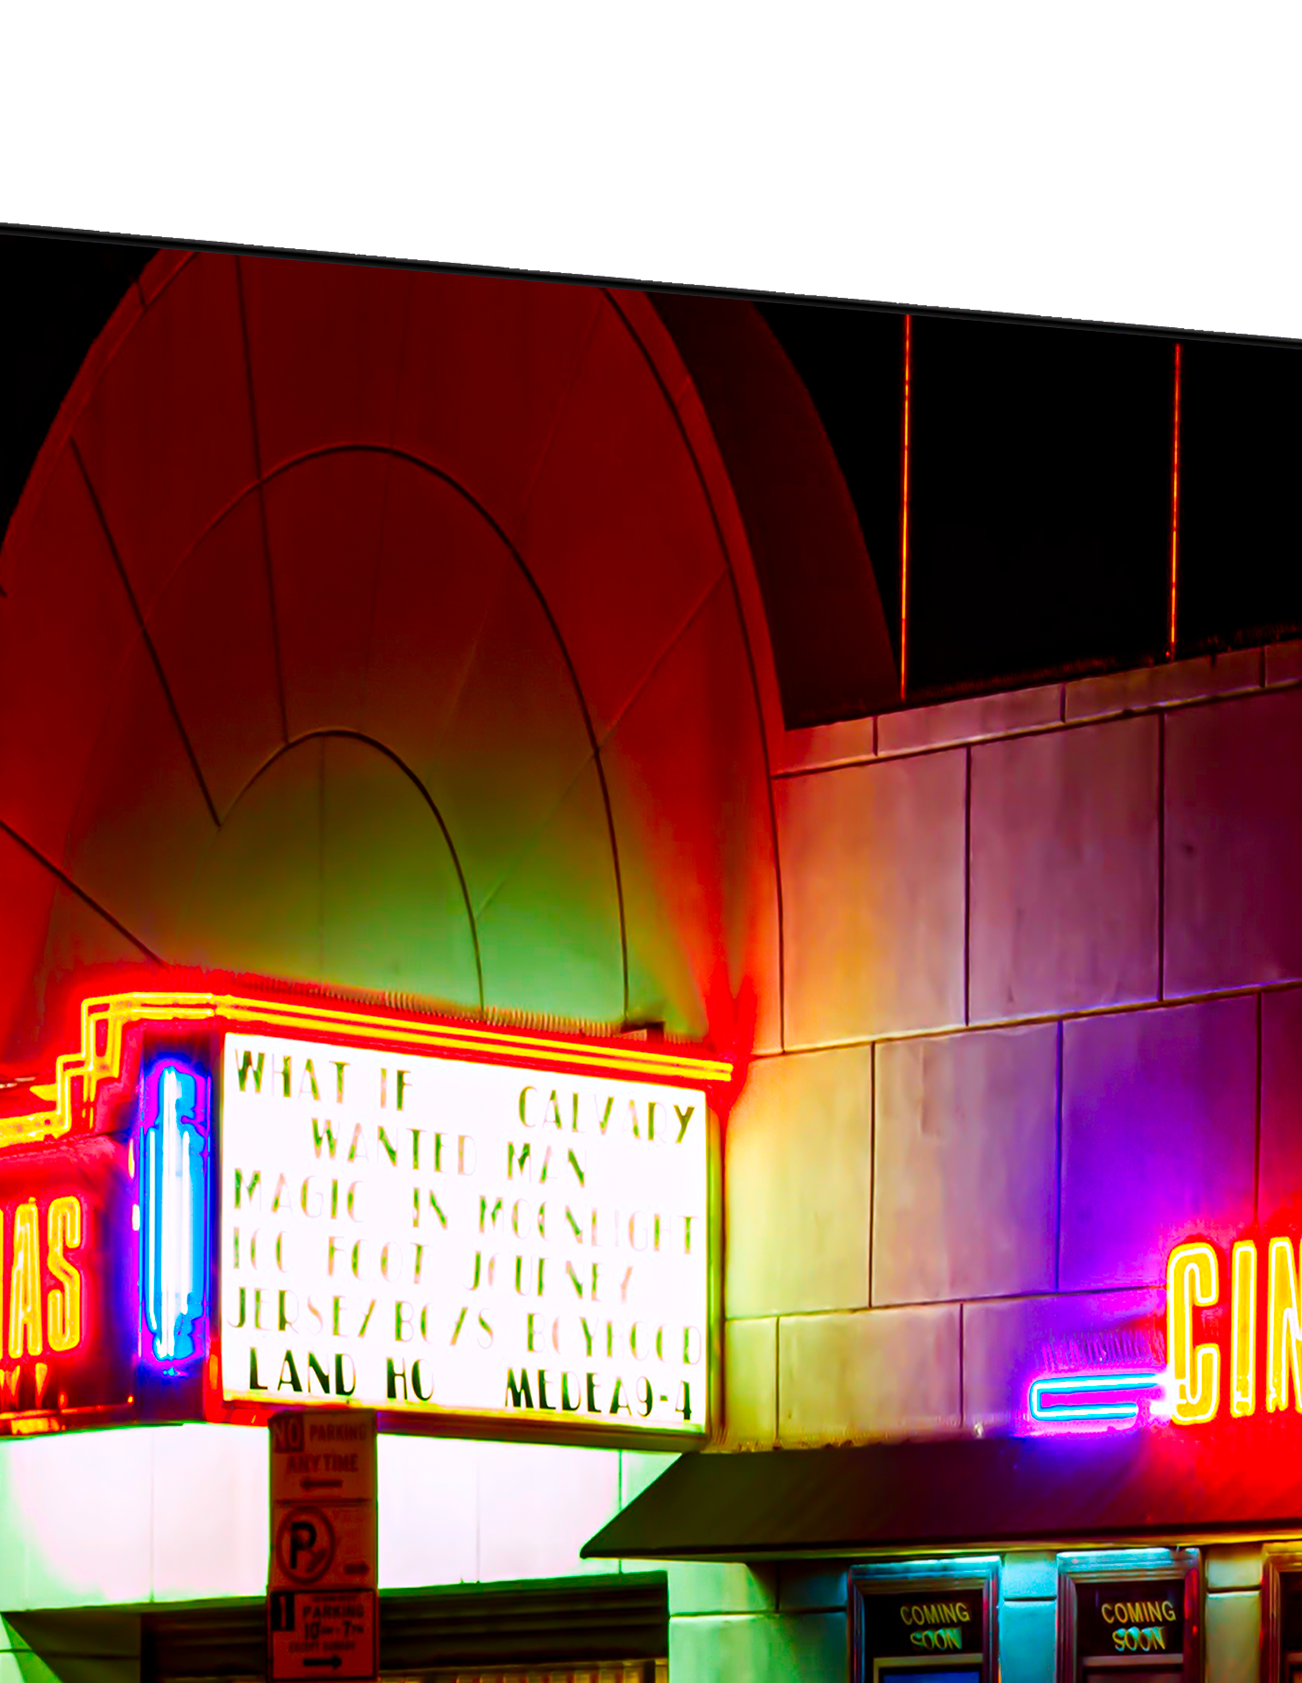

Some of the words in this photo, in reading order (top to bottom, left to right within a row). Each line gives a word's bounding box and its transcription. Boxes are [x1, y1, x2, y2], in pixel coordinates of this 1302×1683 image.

[234, 1049, 351, 1104] WHAT
[379, 1066, 413, 1112] IF
[518, 1084, 695, 1144] CALVARY
[310, 1117, 478, 1177] WANTED
[506, 1140, 588, 1189] MAN
[232, 1167, 365, 1224] MAGIC
[411, 1186, 449, 1230] IN
[248, 1346, 357, 1397] LAND
[273, 1416, 303, 1450] NO
[309, 1424, 366, 1441] PARKING
[286, 1453, 359, 1474] ANYTIME
[302, 1604, 365, 1619] PARKING
[900, 1602, 971, 1626] COMING
[1101, 1601, 1176, 1625] COMING
[910, 1626, 962, 1651] SOON
[1112, 1626, 1165, 1652] SOON
